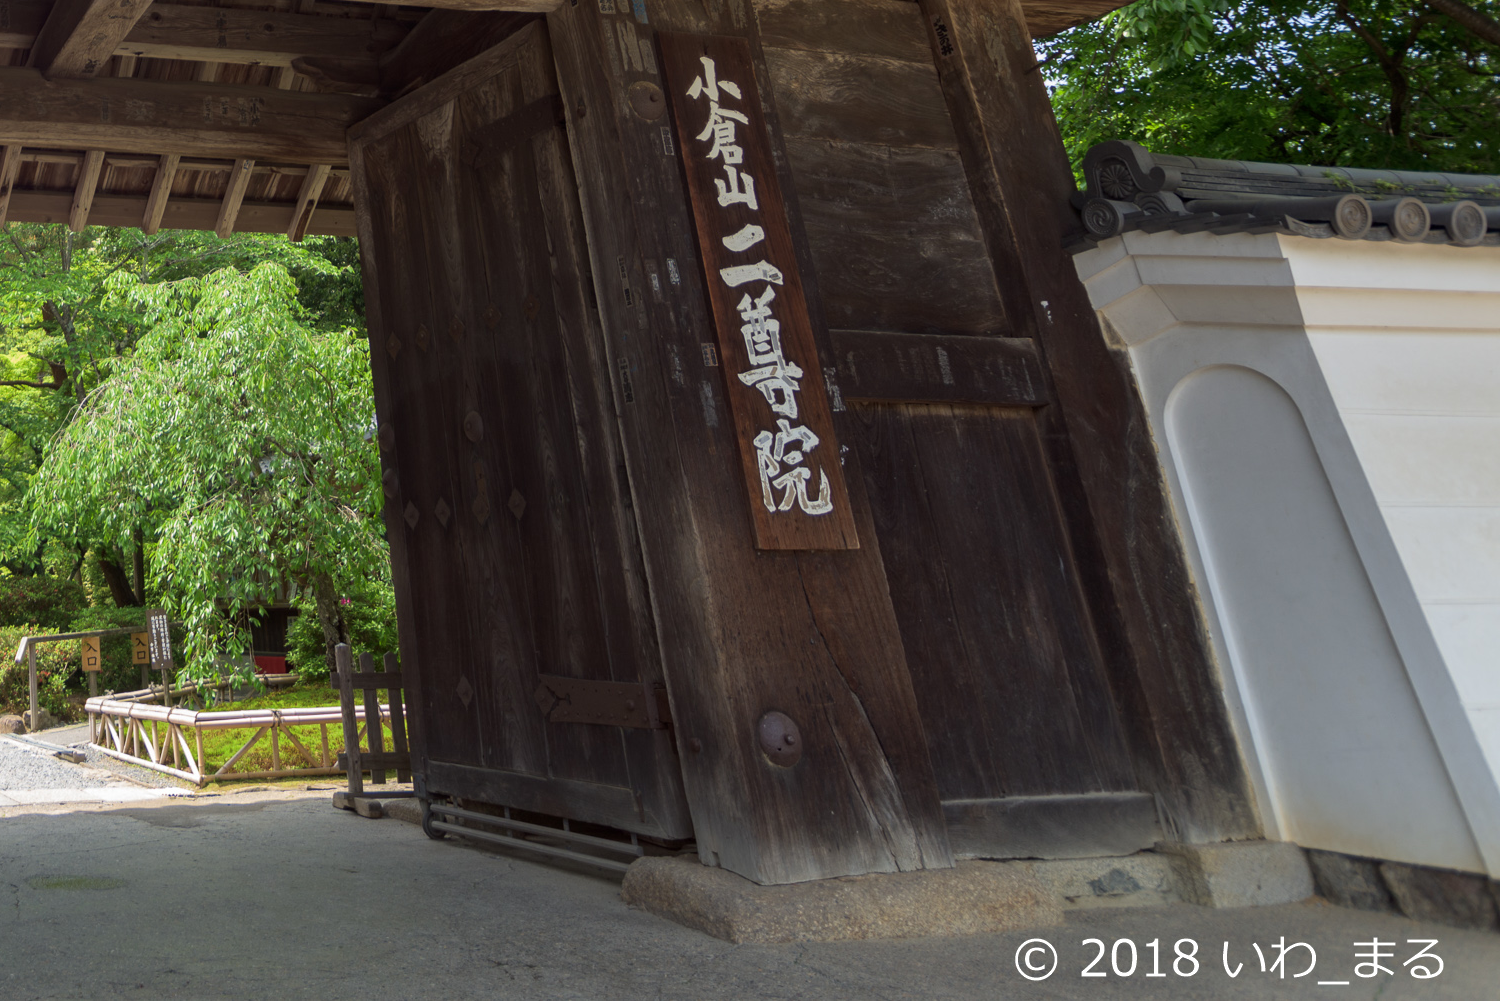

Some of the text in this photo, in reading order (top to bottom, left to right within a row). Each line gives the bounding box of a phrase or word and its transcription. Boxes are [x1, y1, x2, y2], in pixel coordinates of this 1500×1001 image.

[684, 55, 835, 516] 小倉山二尊院
[86, 643, 97, 665] 入口
[136, 637, 146, 659] 入口
